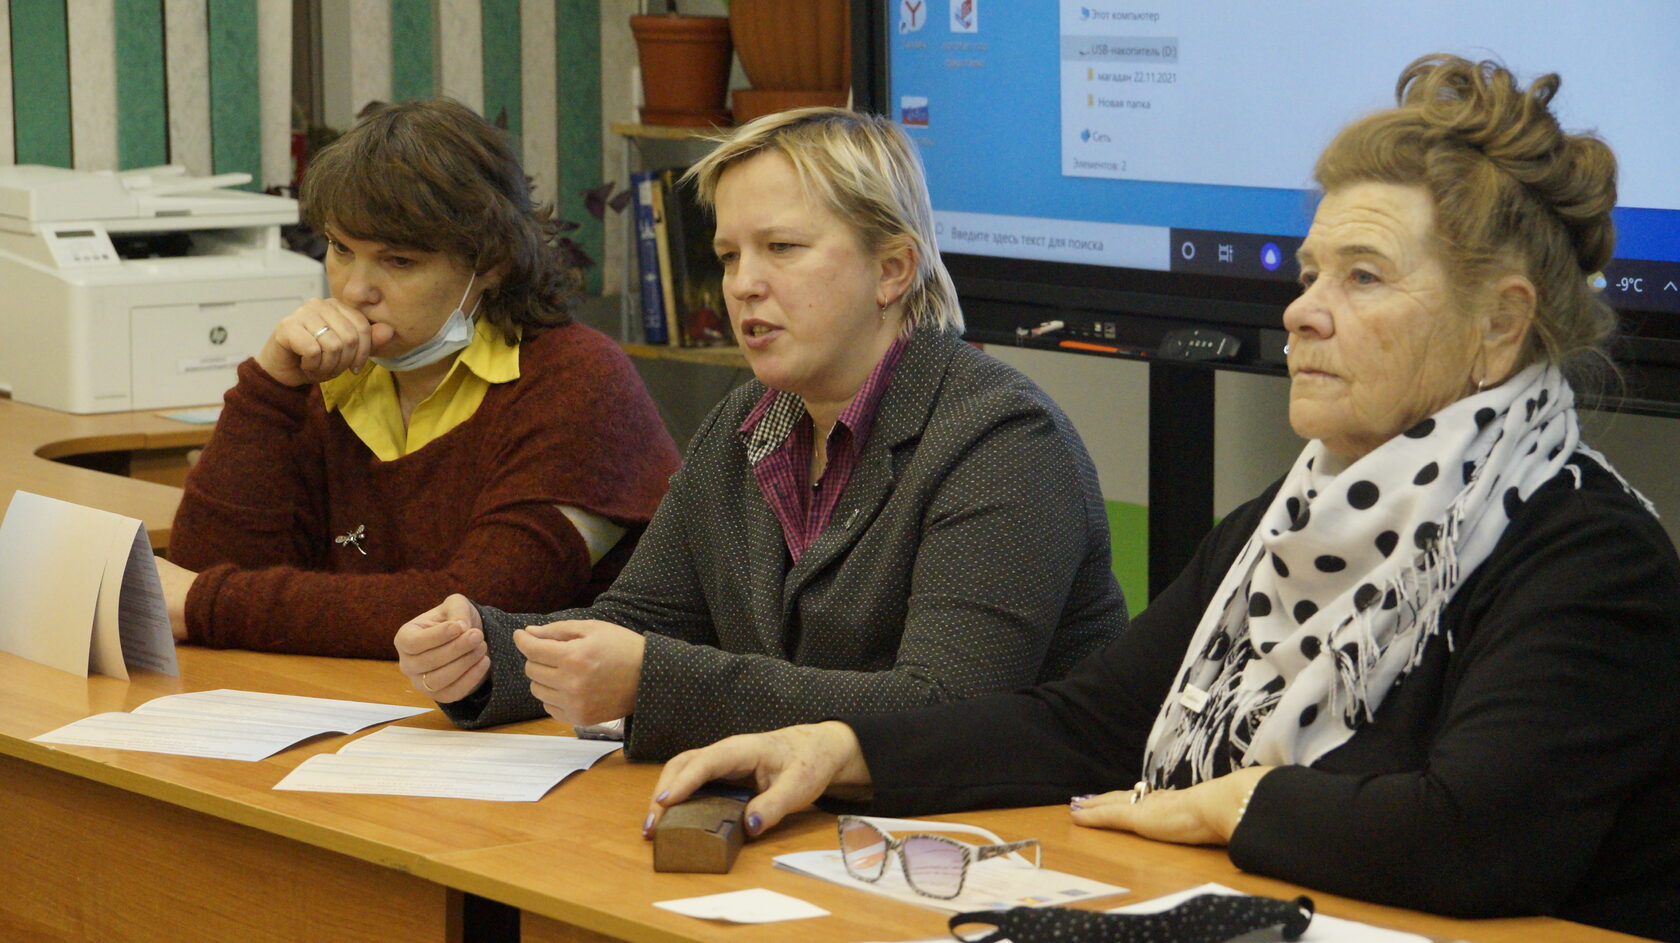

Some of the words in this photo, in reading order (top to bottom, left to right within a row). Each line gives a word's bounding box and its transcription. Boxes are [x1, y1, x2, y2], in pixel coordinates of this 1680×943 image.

[1091, 8, 1110, 19] Этот
[1112, 11, 1160, 22] компьютер
[1091, 44, 1160, 57] USB-накопитель
[1098, 73, 1132, 82] магадан
[1134, 71, 1177, 84] 22.11.2021
[1098, 97, 1124, 108] Новая
[1126, 100, 1151, 110] папка
[1092, 131, 1111, 143] Сеть
[1121, 160, 1127, 172] 2
[951, 226, 989, 243] Введите
[992, 231, 1019, 246] здесь
[1021, 234, 1046, 248] текст
[1048, 236, 1067, 250] для
[1068, 239, 1104, 252] поиска
[1615, 277, 1644, 293] -9°C
